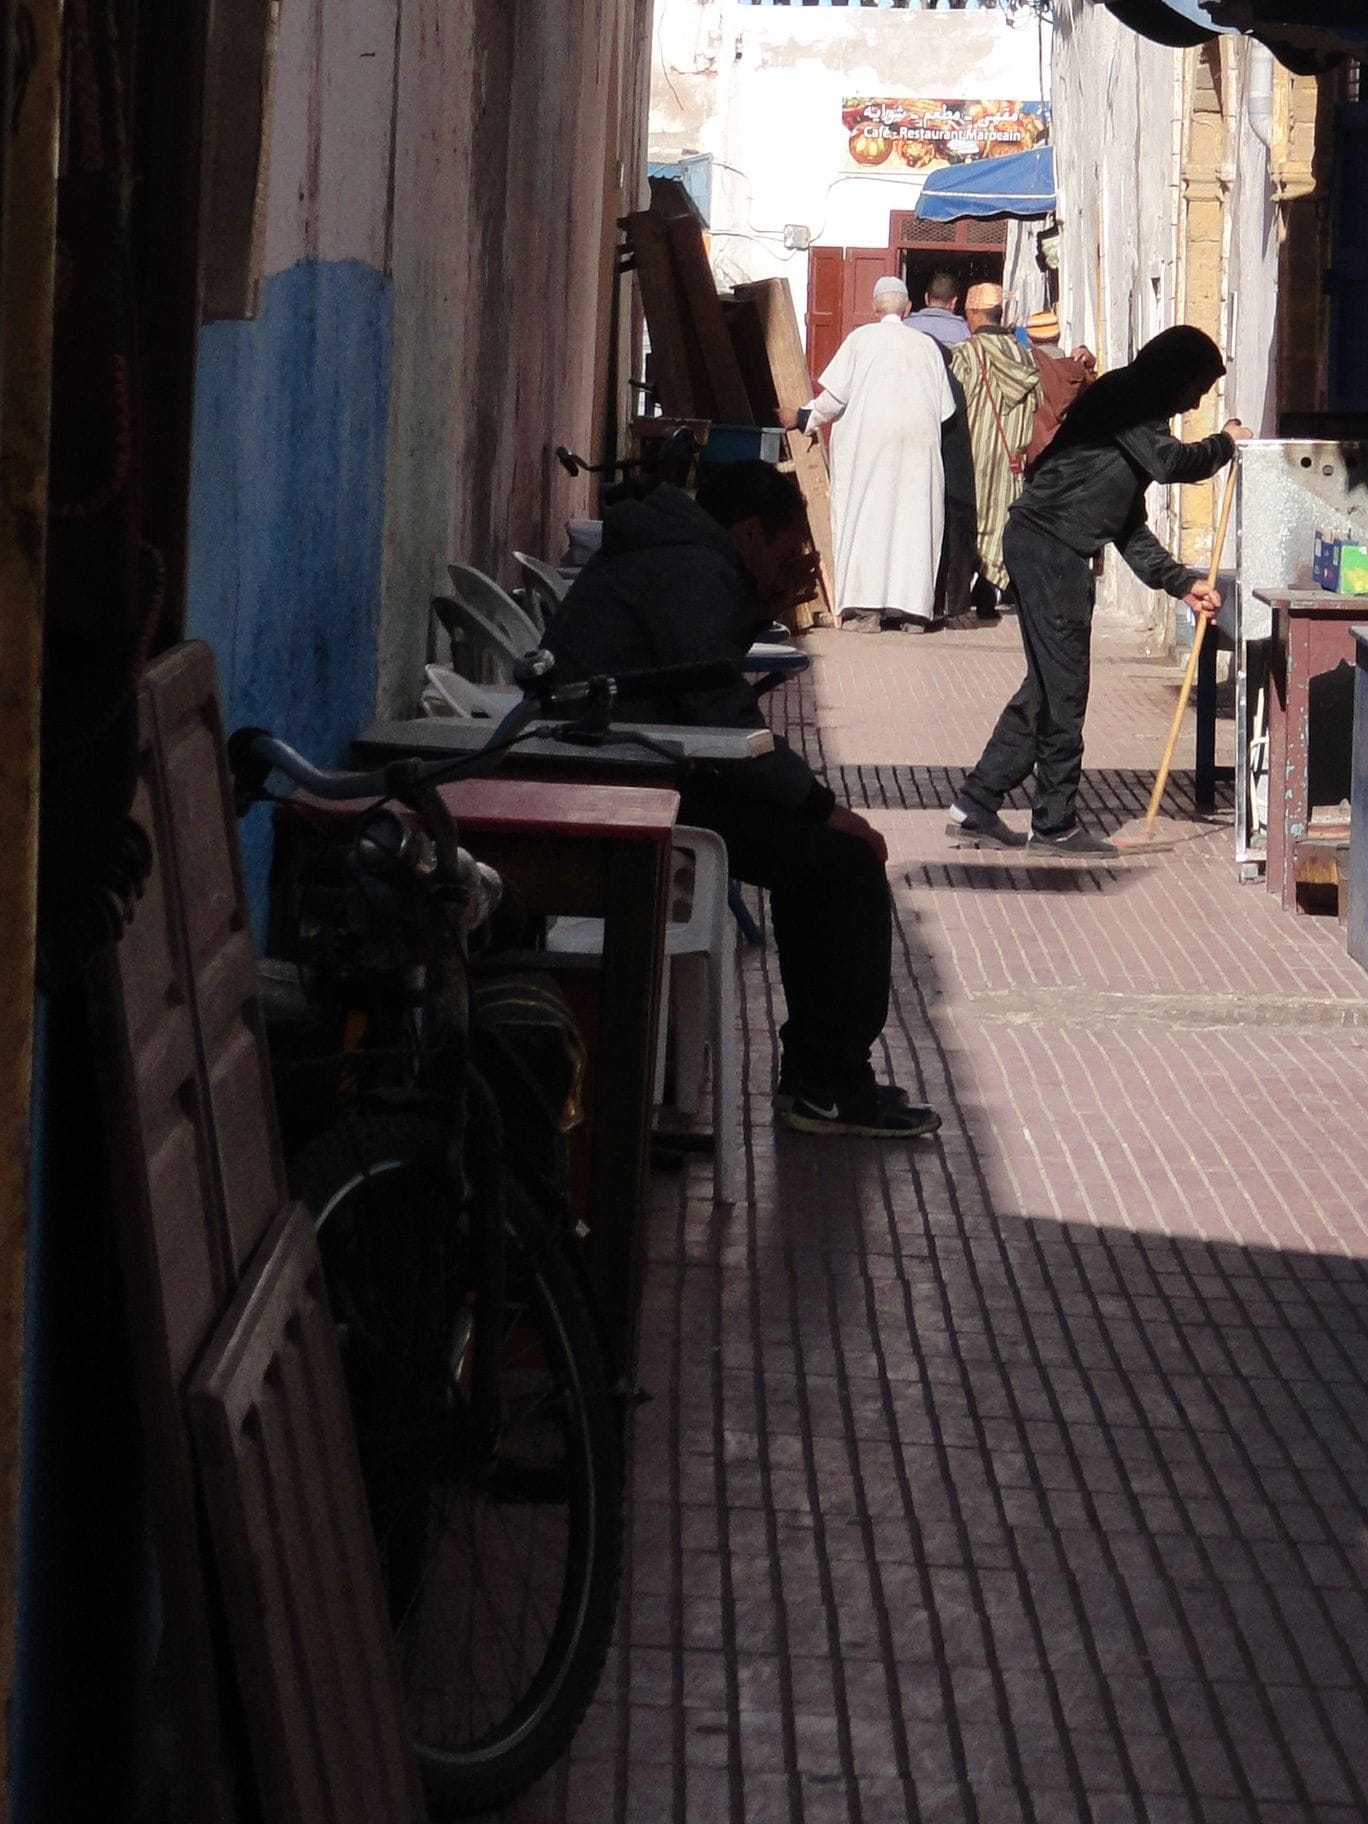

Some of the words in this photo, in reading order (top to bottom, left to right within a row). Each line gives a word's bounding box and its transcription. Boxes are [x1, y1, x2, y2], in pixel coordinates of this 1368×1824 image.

[864, 126, 890, 139] Café
[900, 127, 964, 141] Restaurant
[966, 129, 1021, 142] Marocain
